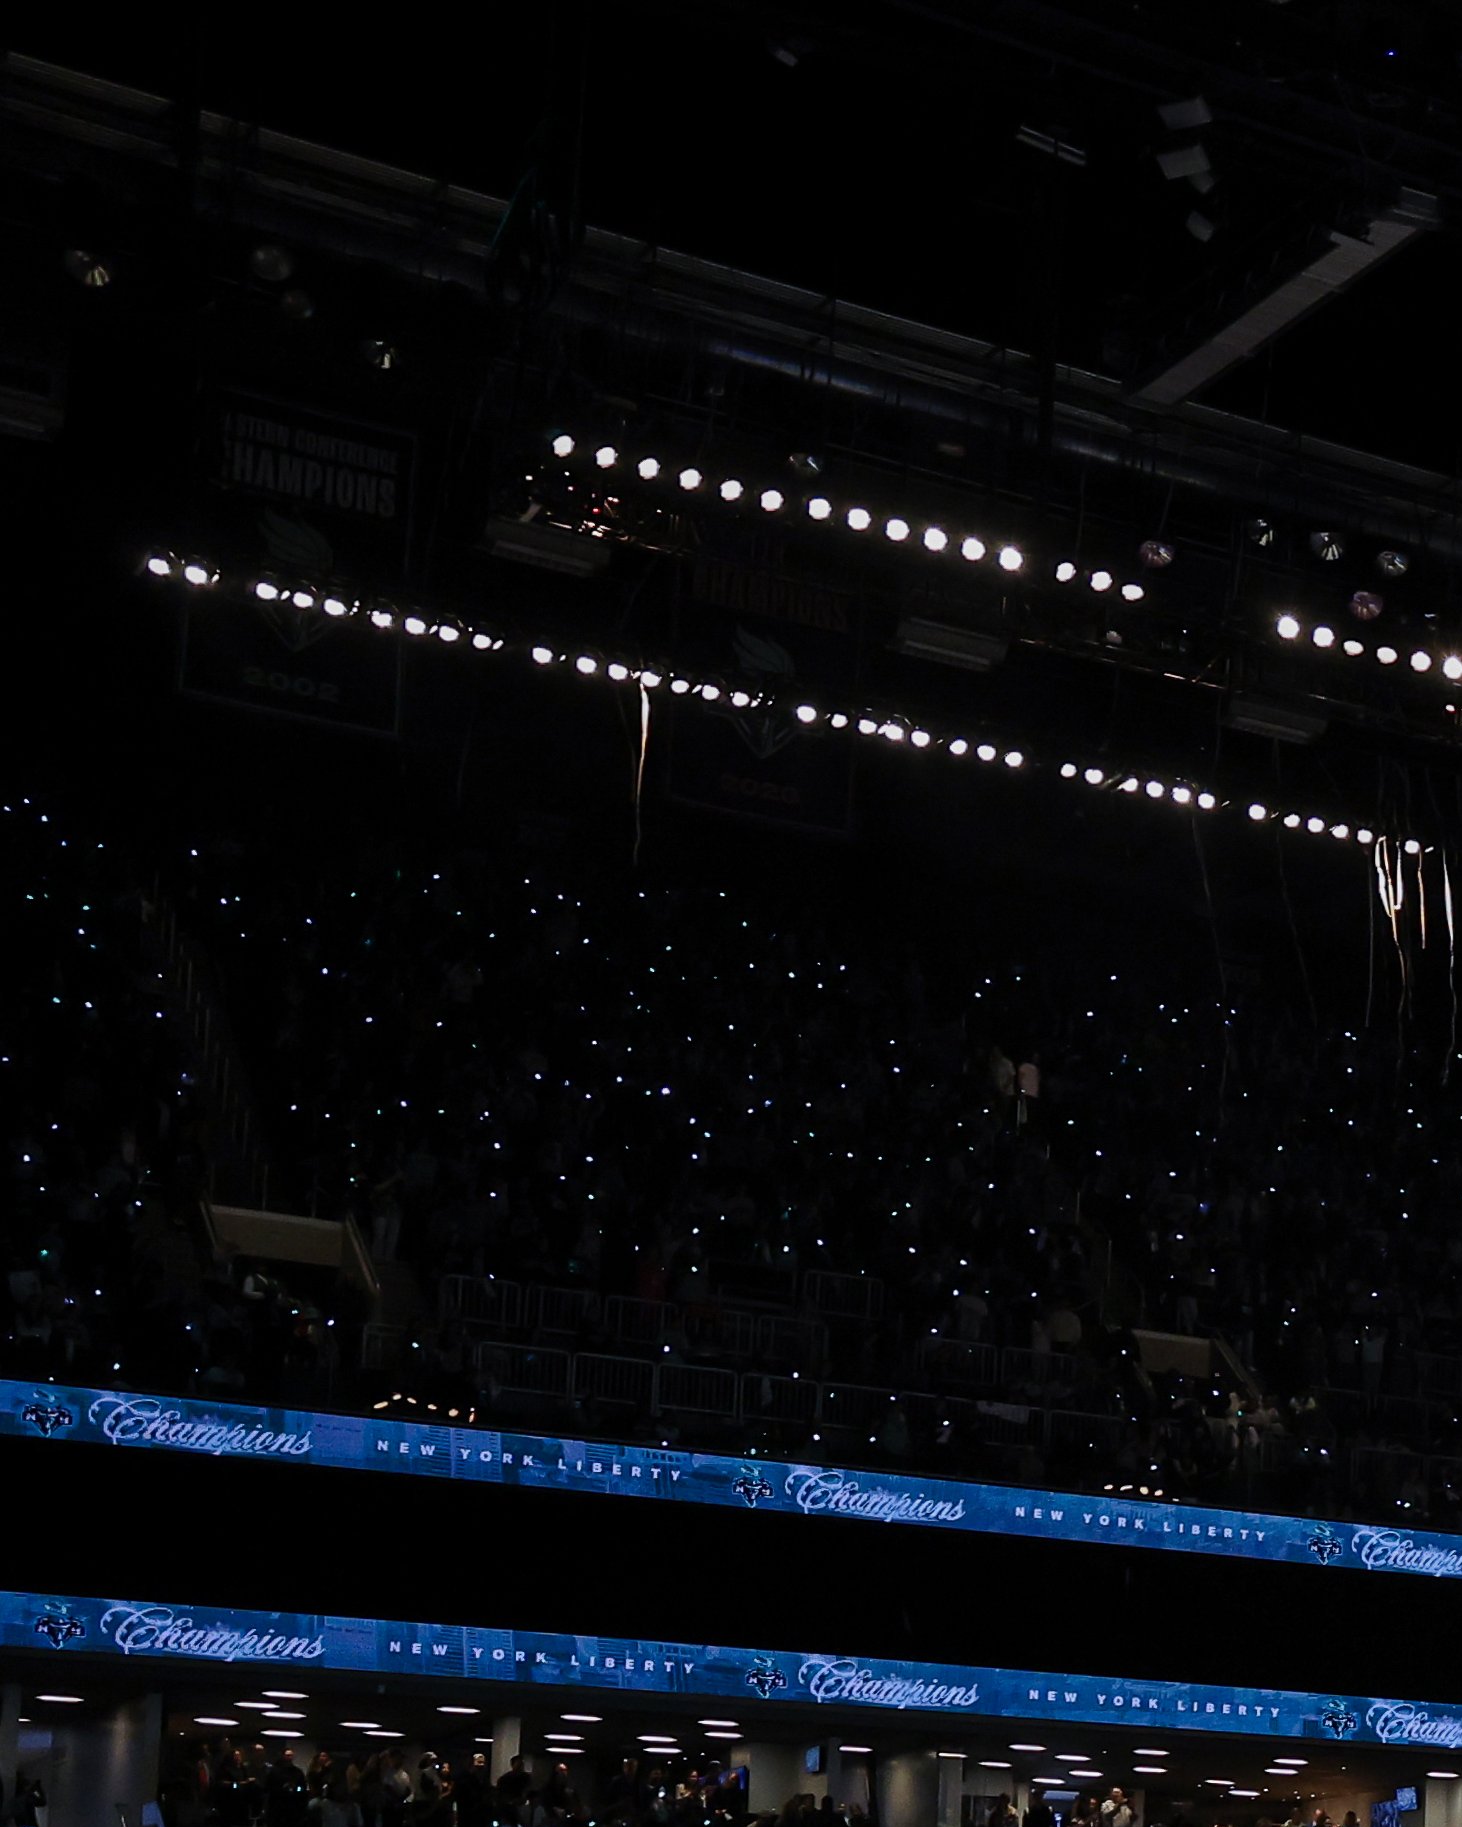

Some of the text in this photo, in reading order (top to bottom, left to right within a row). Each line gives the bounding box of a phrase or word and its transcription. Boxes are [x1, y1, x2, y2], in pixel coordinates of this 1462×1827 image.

[226, 439, 395, 517] HAMPIONS
[88, 1398, 312, 1455] Champions
[378, 1439, 436, 1457] NEW
[460, 1447, 535, 1469] YORK
[557, 1457, 682, 1482] LIBERTY
[784, 1470, 966, 1522] Champions
[1015, 1505, 1064, 1522] NEW
[1082, 1512, 1145, 1531] YORK
[1162, 1520, 1268, 1543] LIBERTY
[100, 1606, 324, 1661] Champions
[389, 1640, 448, 1657] NEW
[472, 1646, 547, 1665] YORK
[570, 1654, 695, 1675] LIBERTY
[798, 1659, 980, 1710] Champions
[1028, 1688, 1077, 1703] NEW
[1096, 1694, 1158, 1711] YORK
[1177, 1701, 1281, 1718] LIBERTY
